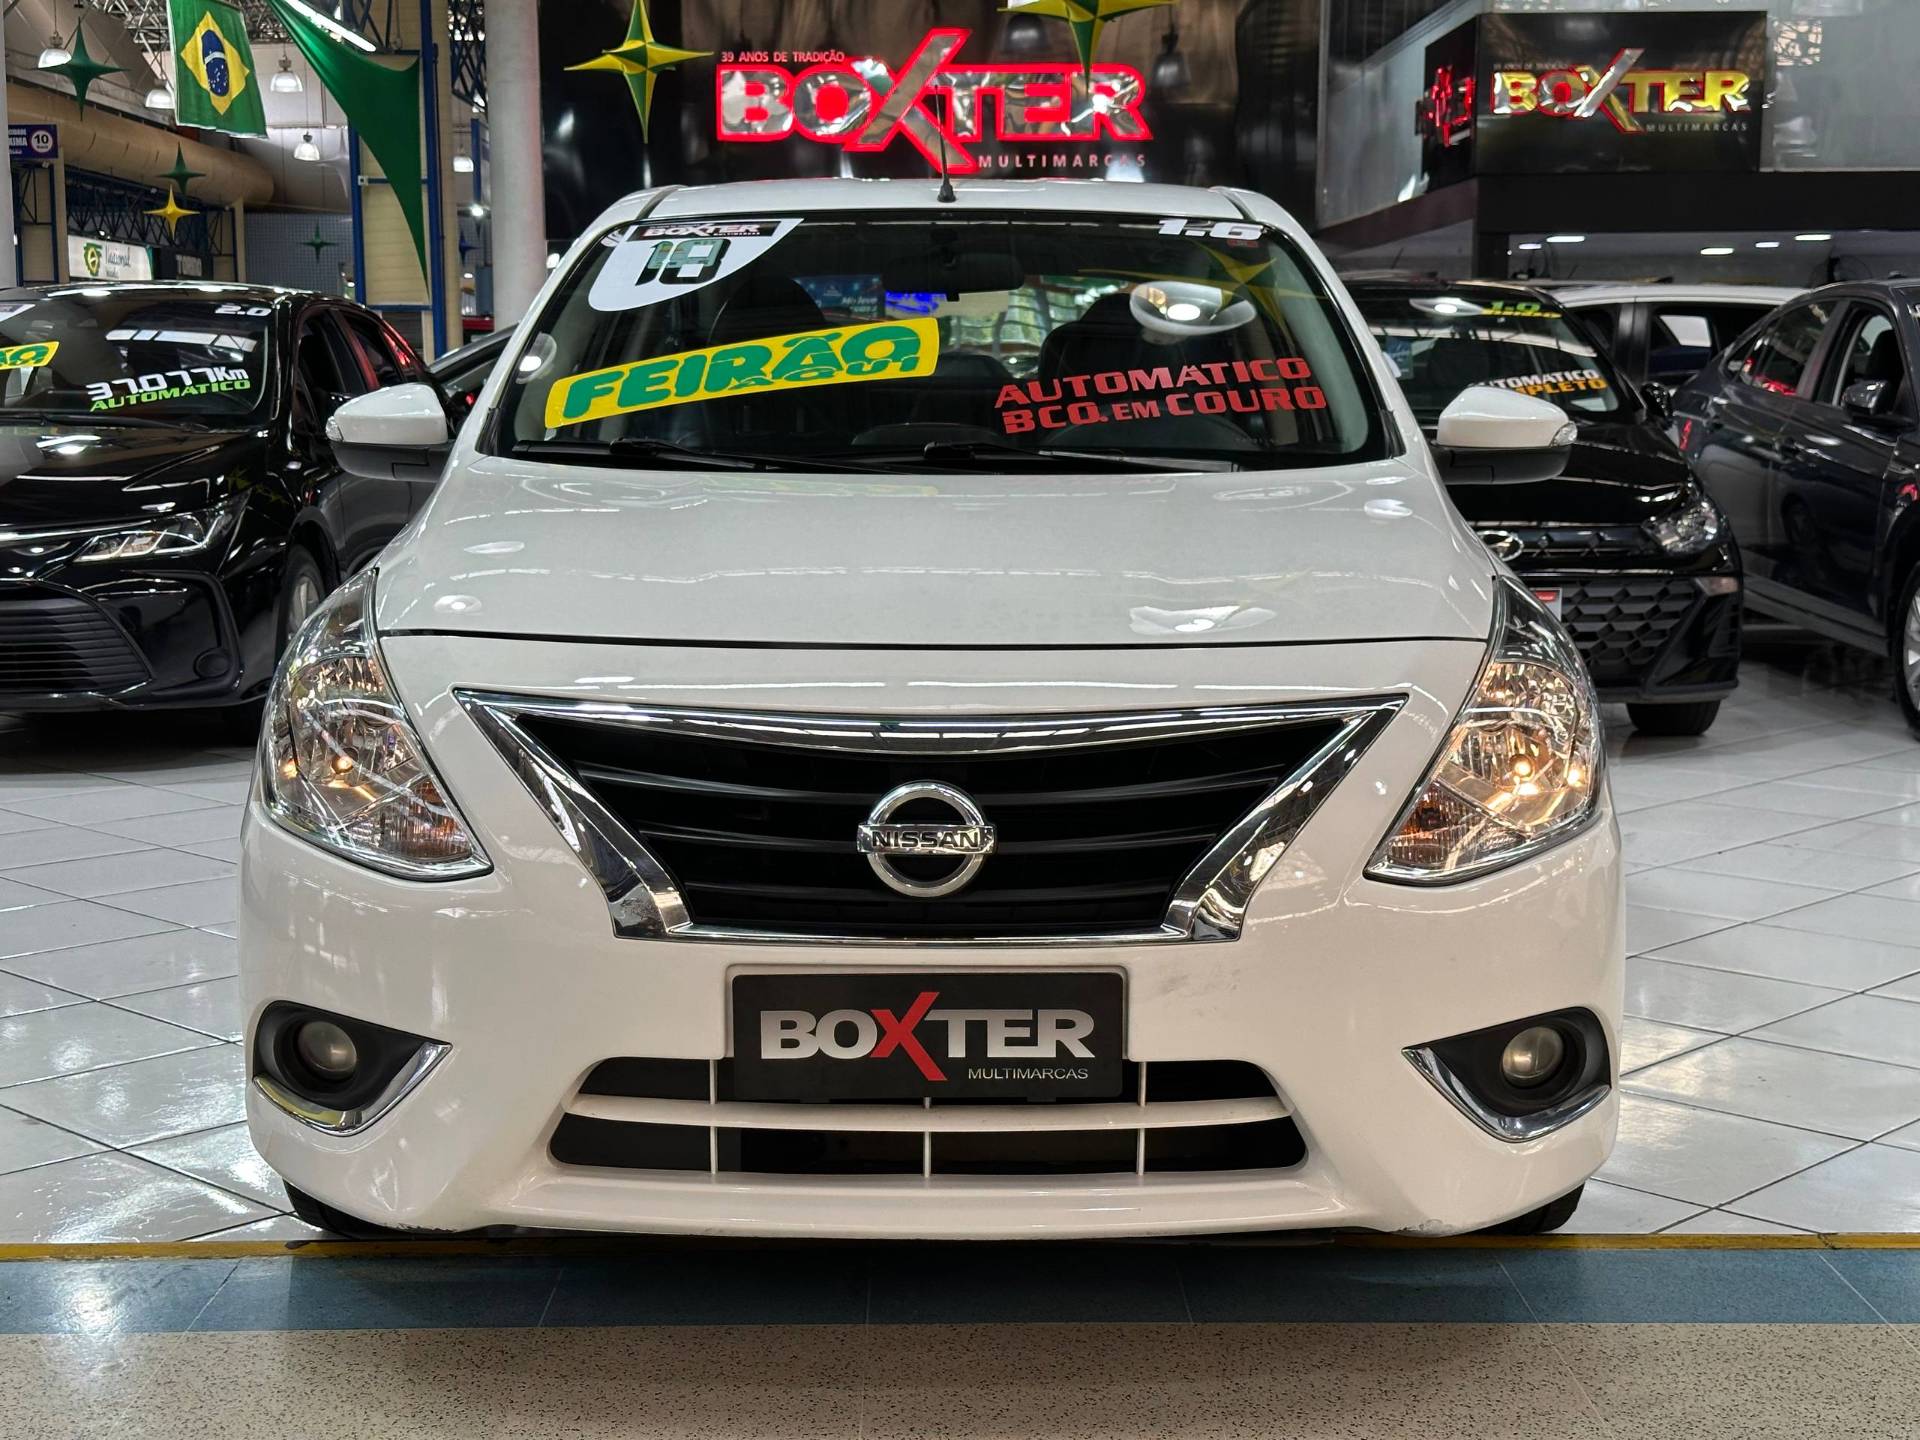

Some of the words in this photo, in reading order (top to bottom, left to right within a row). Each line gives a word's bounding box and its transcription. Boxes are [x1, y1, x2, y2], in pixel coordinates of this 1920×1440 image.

[721, 51, 735, 62] 39
[739, 51, 769, 62] ANOS
[773, 51, 788, 62] DE
[793, 48, 845, 64] TRADIÇÃO
[1490, 48, 1751, 133] BOXTER
[716, 27, 1153, 174] BOXTER
[34, 134, 49, 145] 10
[978, 154, 1147, 168] MULTIMARCAS
[643, 223, 760, 237] BOXTER
[1159, 219, 1263, 240] 1.6
[214, 304, 272, 317] 2.0
[562, 325, 921, 419] FEIRÃO
[1111, 399, 1161, 421] EM
[1165, 386, 1327, 416] COURO
[872, 831, 979, 848] NISSAN
[760, 991, 1096, 1081] BOXTER
[968, 1067, 1089, 1080] MULTIMARCAS
